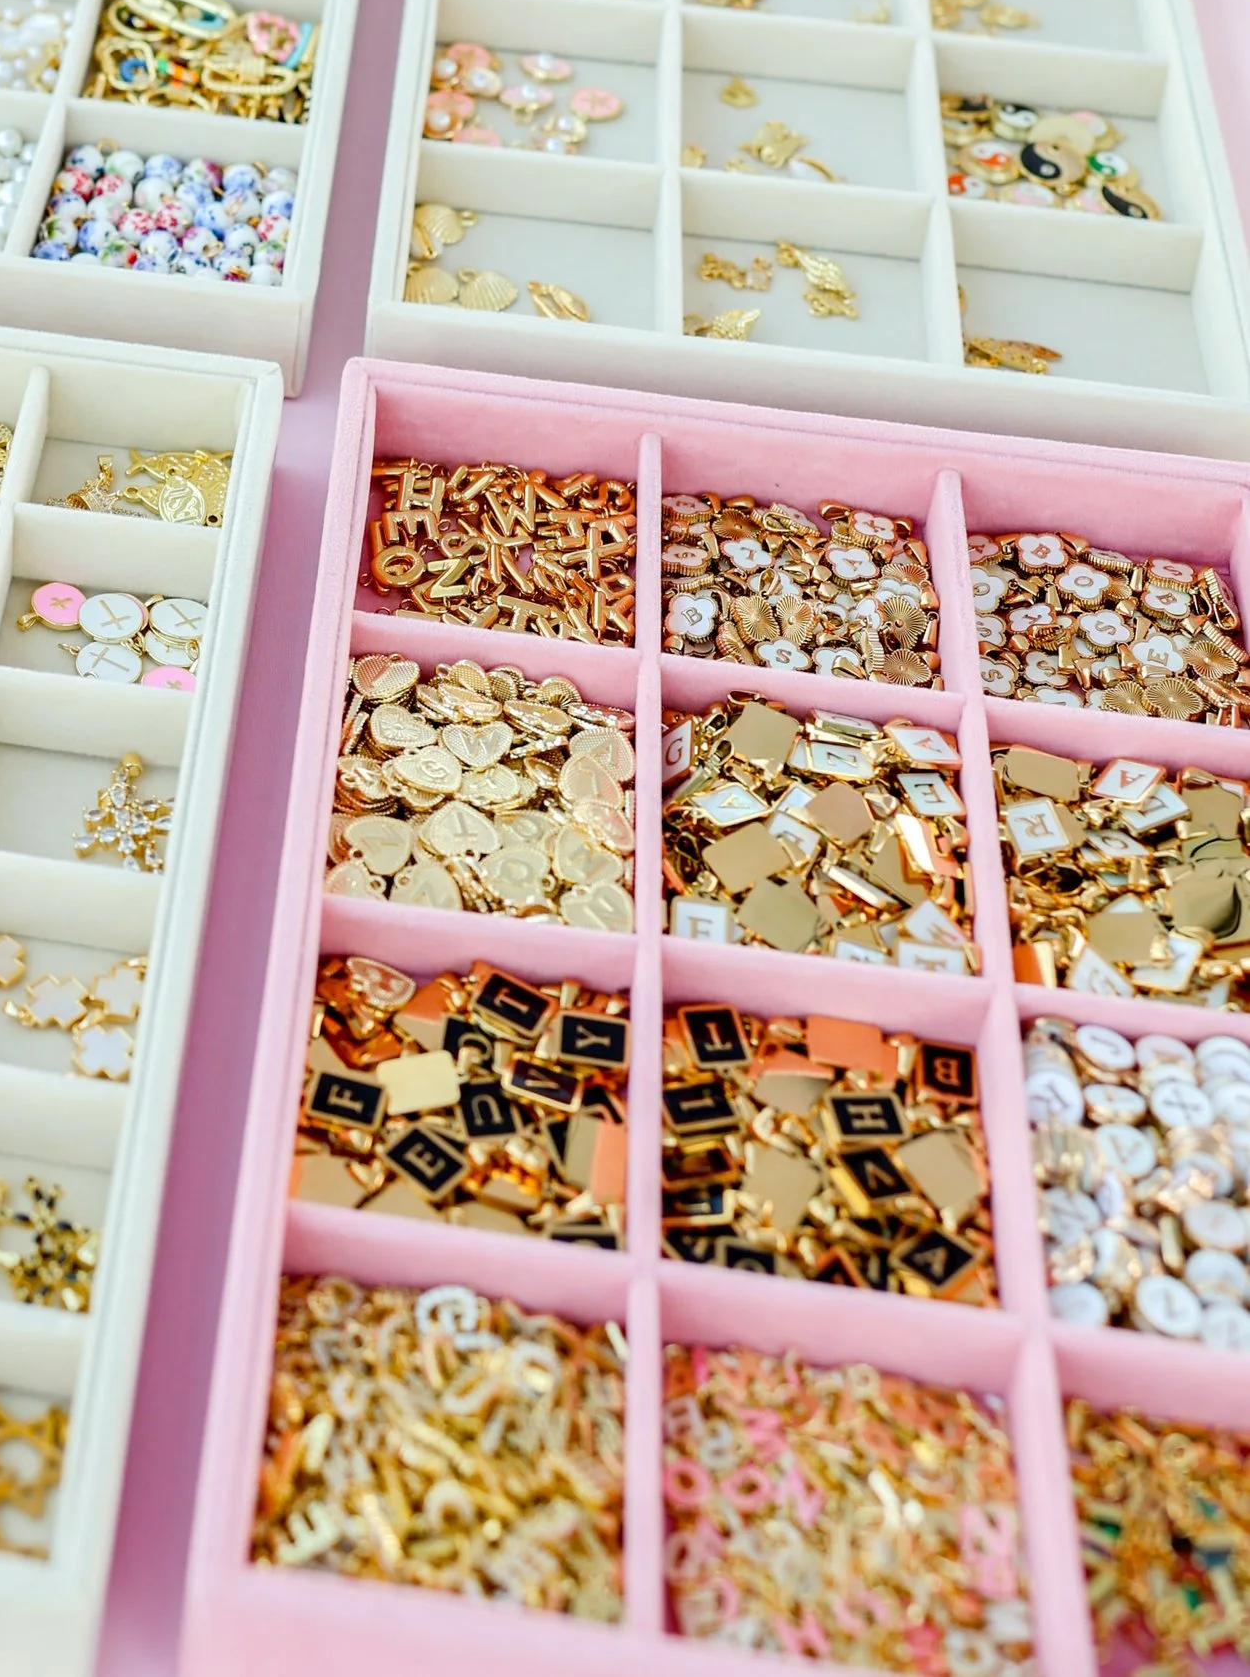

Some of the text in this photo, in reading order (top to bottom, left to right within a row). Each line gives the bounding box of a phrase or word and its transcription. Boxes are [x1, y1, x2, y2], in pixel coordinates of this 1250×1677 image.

[398, 472, 445, 519] H
[485, 482, 535, 536] W
[382, 511, 440, 547] E
[1031, 543, 1050, 559] B
[371, 545, 426, 588] O
[1163, 564, 1183, 578] S
[1156, 591, 1178, 606] B
[593, 591, 635, 635] K
[681, 607, 703, 626] B
[775, 648, 792, 665] S
[1146, 648, 1169, 666] E
[980, 668, 1004, 683] S
[665, 737, 683, 767] G
[914, 782, 947, 804] E
[1014, 813, 1055, 838] R
[575, 1024, 611, 1050] Y
[704, 1022, 733, 1051] T
[933, 1057, 962, 1087] B
[326, 1084, 364, 1113] F
[846, 1103, 889, 1130] H
[403, 1142, 446, 1180] E
